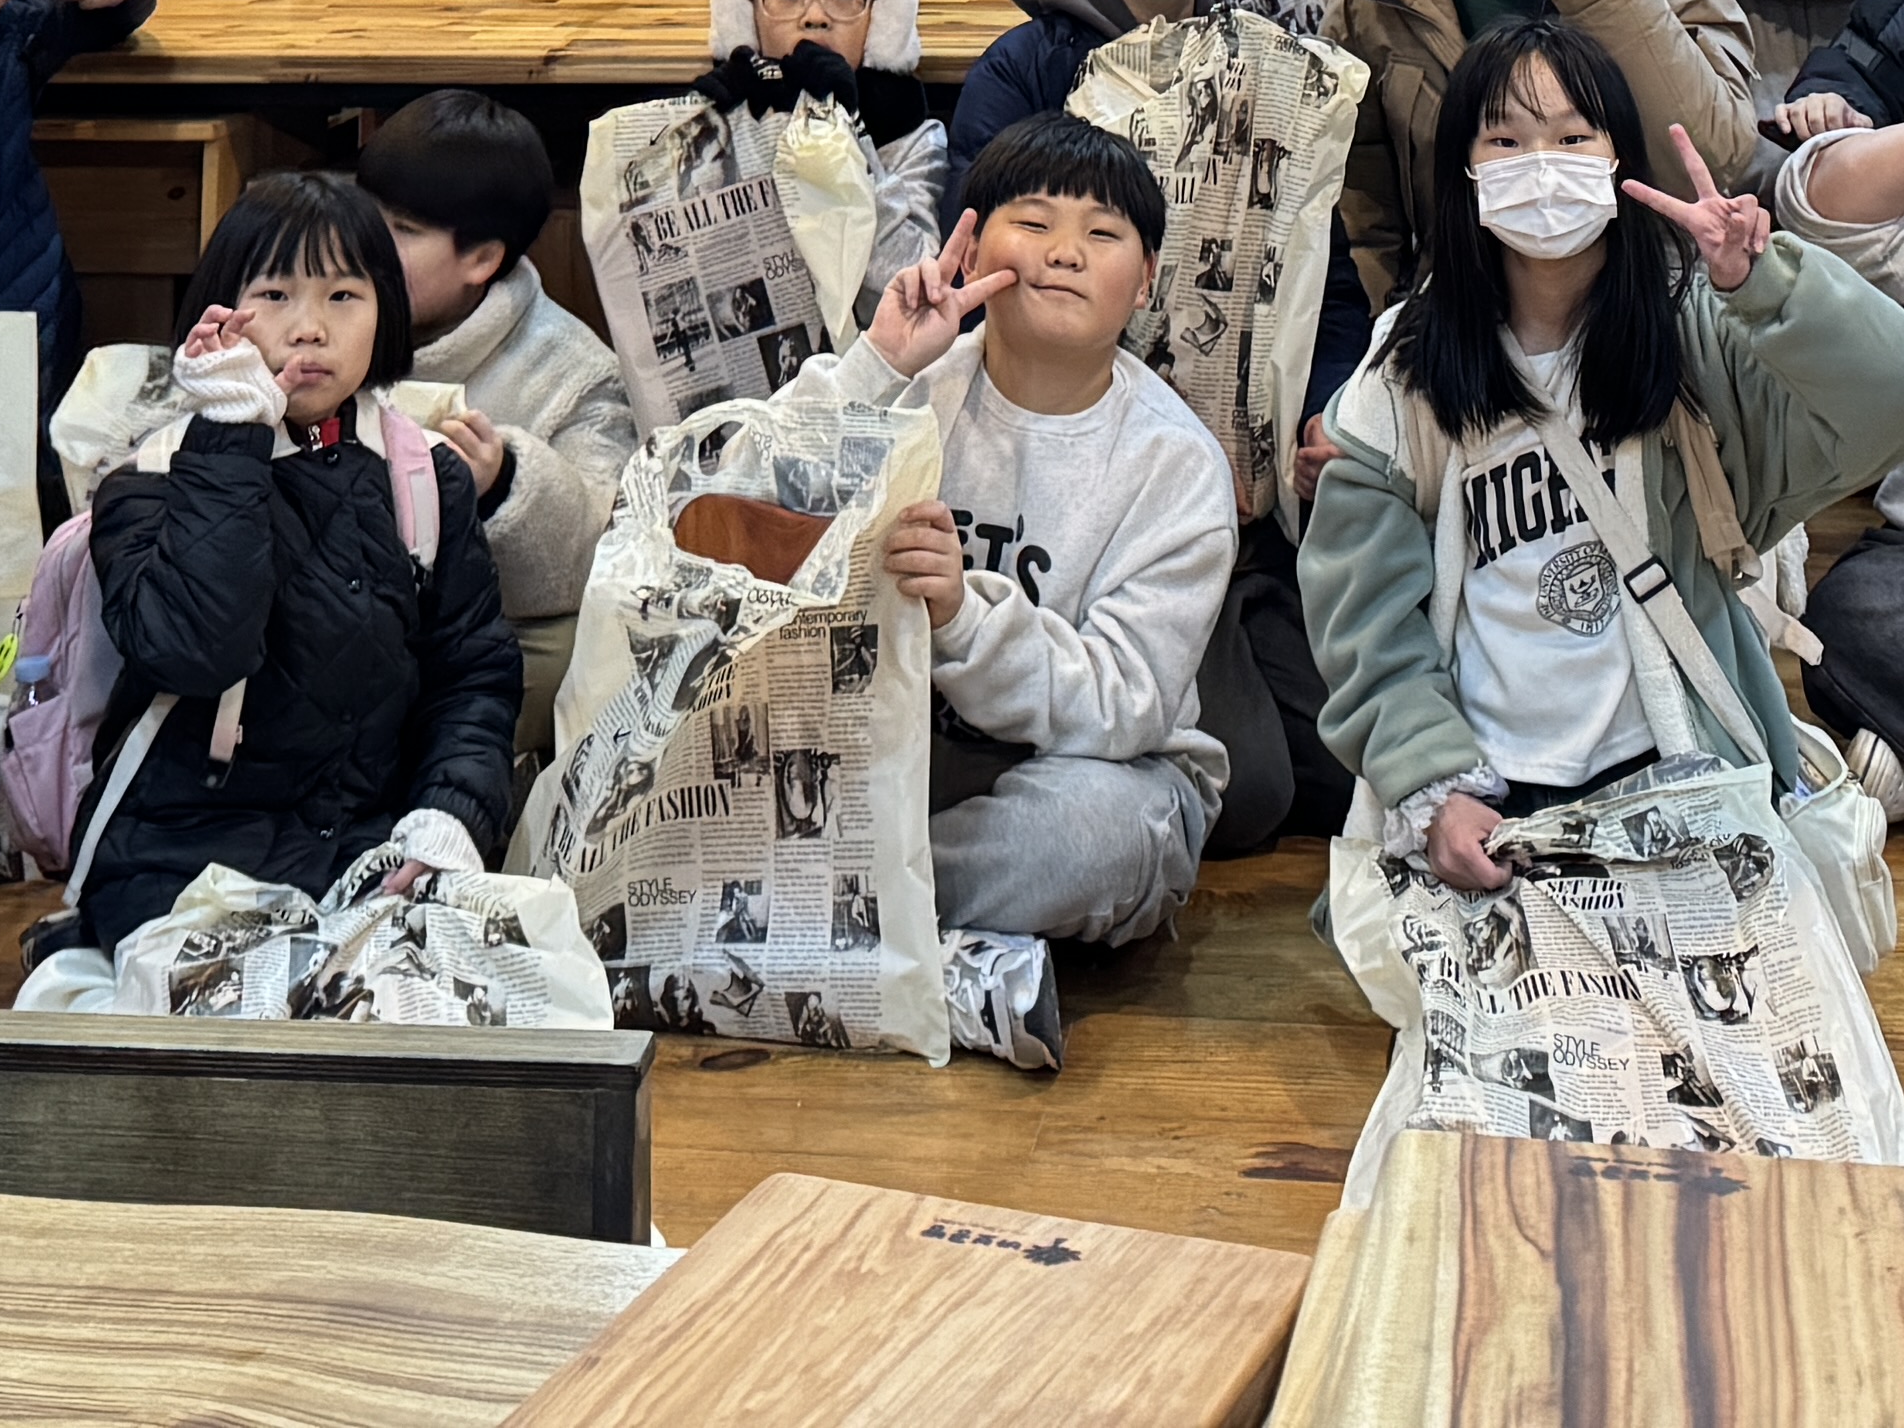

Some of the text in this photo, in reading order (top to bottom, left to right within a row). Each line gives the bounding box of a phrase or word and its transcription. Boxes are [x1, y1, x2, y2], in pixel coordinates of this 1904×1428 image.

[654, 210, 681, 242] BE
[683, 199, 718, 232] ALL
[717, 183, 758, 221] THE
[951, 509, 1052, 608] ET'S
[779, 623, 827, 640] fashion
[646, 783, 732, 827] FASHION
[627, 878, 673, 896] STYLE
[1547, 879, 1628, 895] SET THE
[628, 890, 697, 908] ODYSSEY
[1509, 971, 1557, 1011] THE
[1553, 1033, 1601, 1057] STYLE
[1553, 1049, 1630, 1071] ODYSSEY
